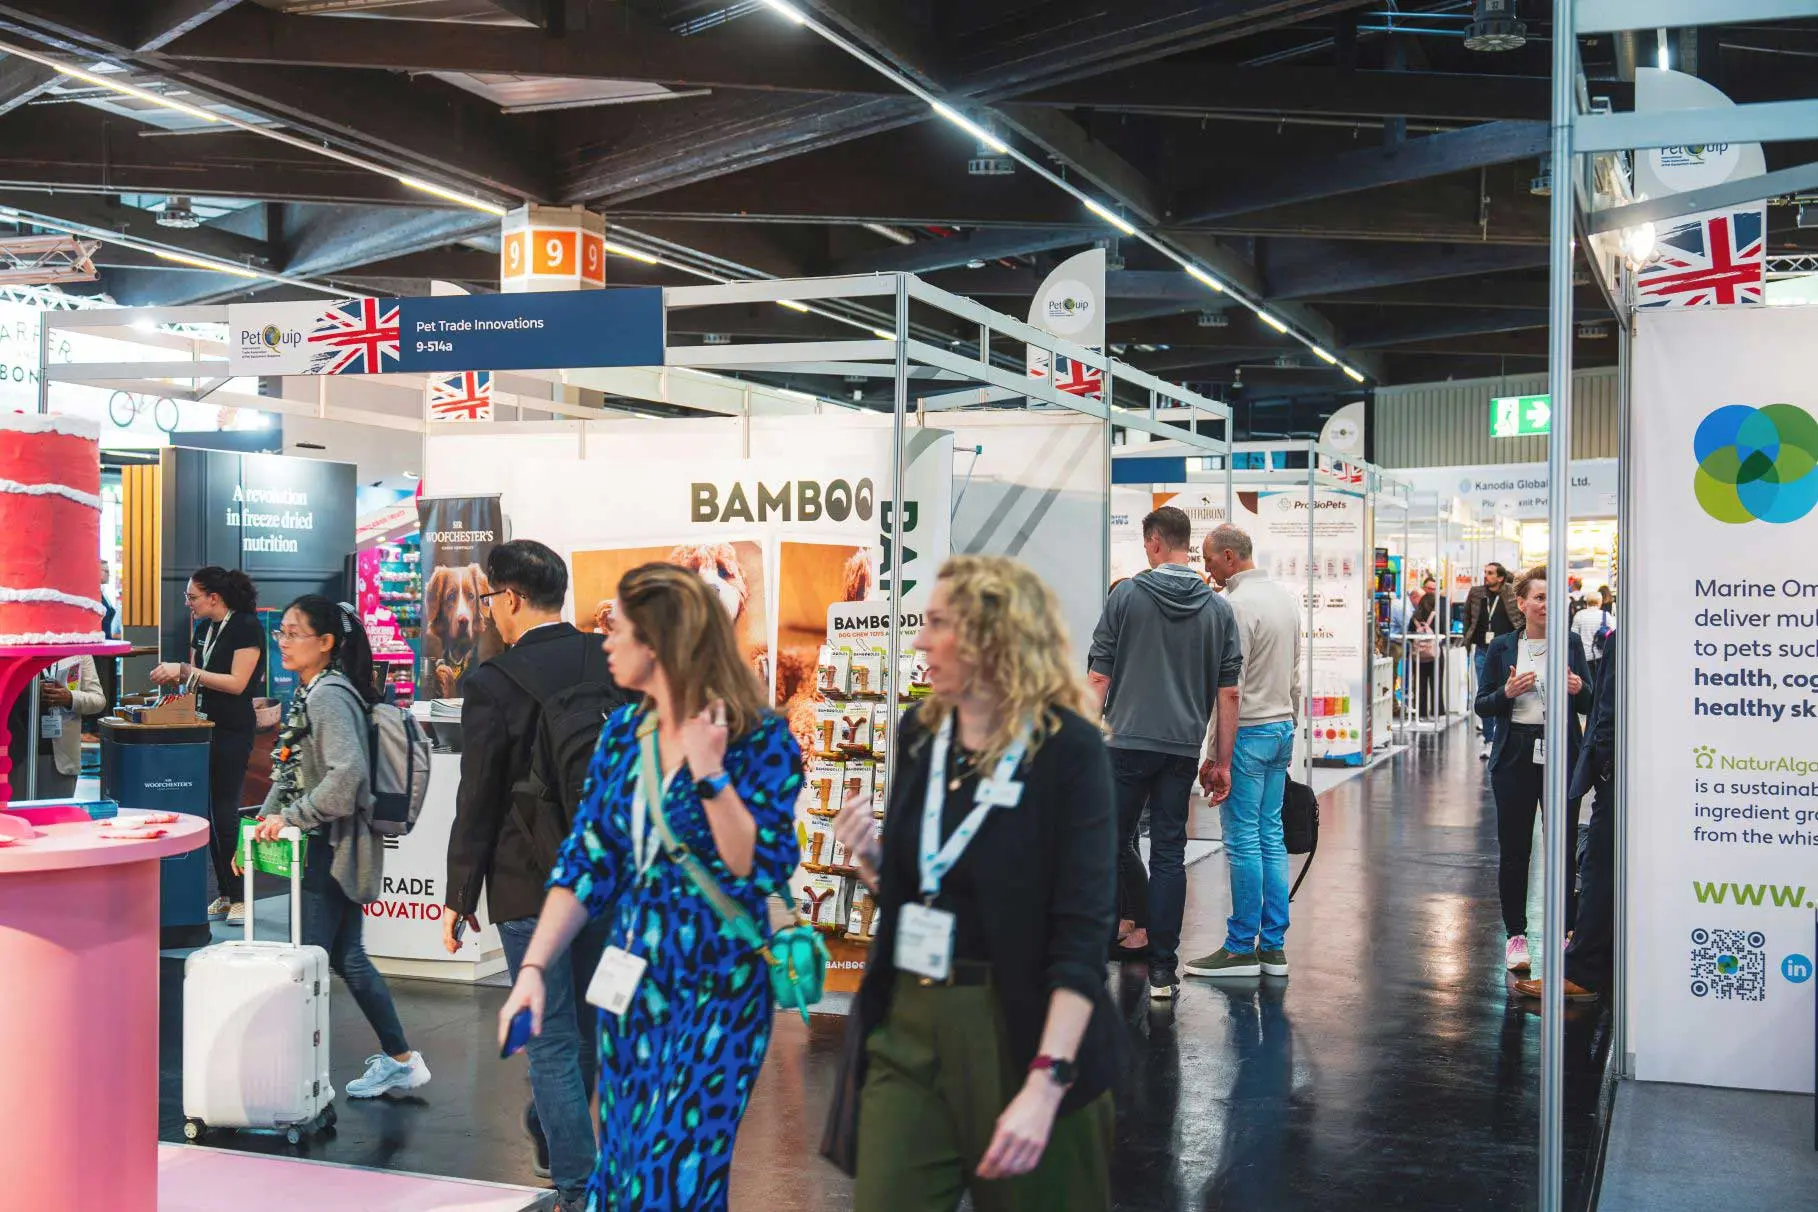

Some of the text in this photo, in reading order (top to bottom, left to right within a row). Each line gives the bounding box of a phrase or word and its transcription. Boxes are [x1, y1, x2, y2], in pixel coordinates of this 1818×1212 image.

[509, 240, 520, 270] 9
[546, 239, 564, 268] 9
[588, 244, 597, 272] 9
[1048, 298, 1089, 314] PetQuip
[416, 317, 544, 332] Pet Trade Innovations
[241, 325, 302, 353] PetQuip
[416, 341, 453, 352] 9-514a
[0, 364, 52, 386] BON
[1475, 476, 1591, 490] Kanodia Global Ltd.
[232, 485, 308, 505] A revolution
[691, 477, 873, 523] BAMBOO
[226, 508, 313, 529] in freeze dried
[243, 534, 298, 552] nutrition
[426, 530, 494, 543] WOOFCHESTER'S
[1695, 579, 1818, 597] Marine Om
[1694, 608, 1771, 627] deliver
[1694, 639, 1818, 662] to pets suc
[1694, 667, 1778, 690] health,
[1694, 697, 1786, 723] healthy
[1695, 778, 1708, 793] is
[1713, 783, 1725, 794] a
[1695, 802, 1790, 822] ingredient
[1694, 826, 1737, 843] from
[1743, 829, 1773, 844] the
[1693, 881, 1815, 908] www.
[361, 900, 447, 921] NOVATIO
